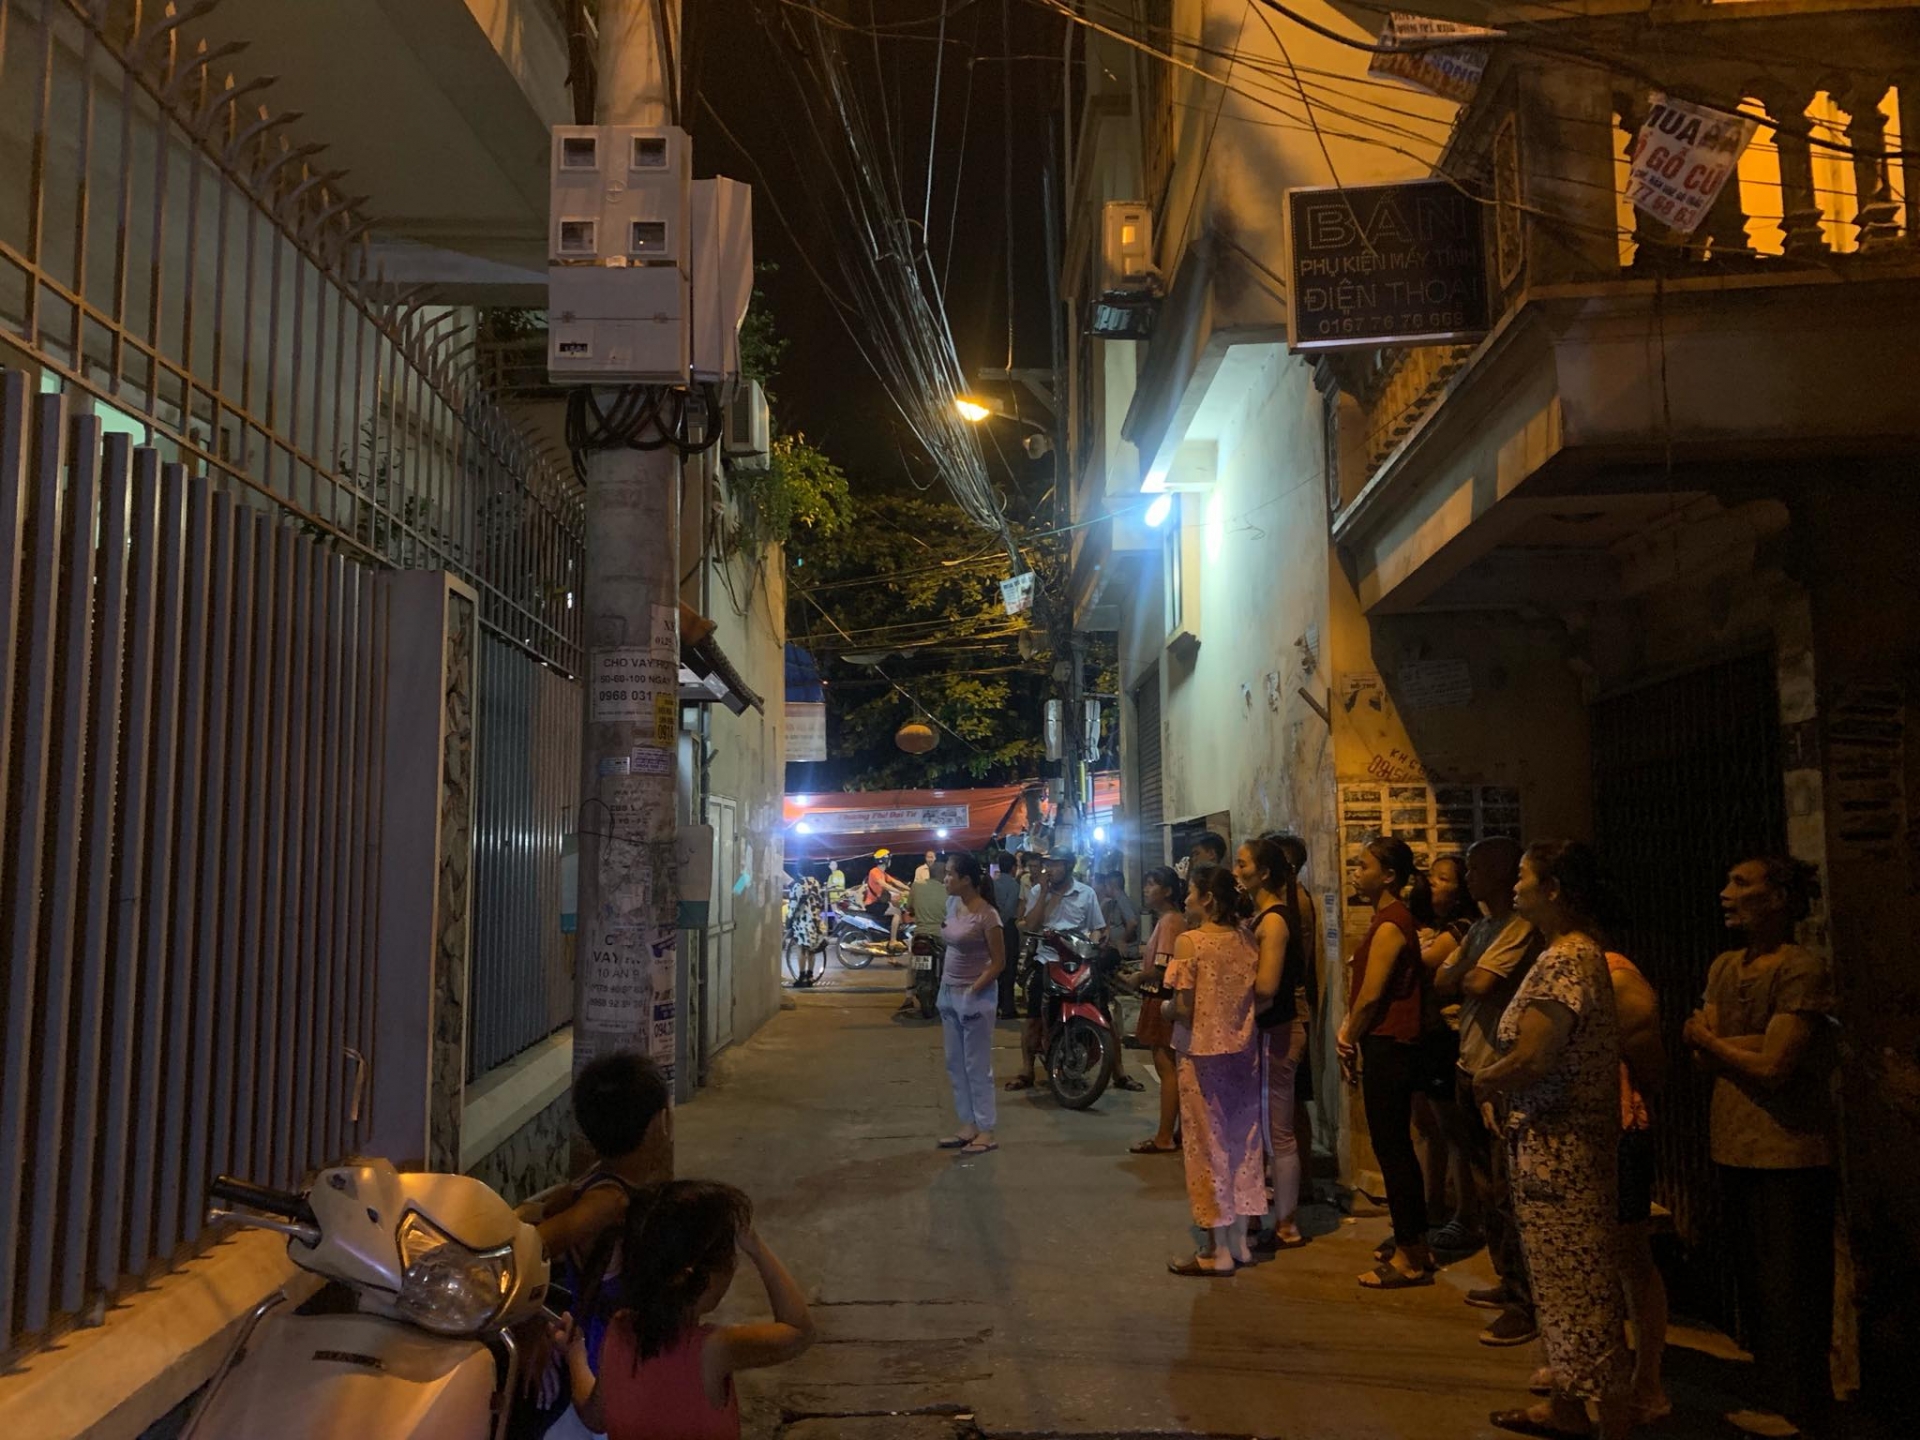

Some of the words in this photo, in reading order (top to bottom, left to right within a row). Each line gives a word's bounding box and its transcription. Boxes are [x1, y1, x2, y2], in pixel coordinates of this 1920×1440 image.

[1307, 187, 1467, 251] BÁN
[1300, 257, 1340, 277] PHỤ
[1343, 249, 1386, 275] KIỆN
[1390, 245, 1430, 270] MÁY
[1304, 278, 1376, 315] ĐIỆN
[1384, 277, 1478, 309] THOẠI
[603, 658, 628, 668] CHO
[631, 658, 653, 668] VAY
[599, 690, 627, 701] 0968
[631, 690, 652, 701] 031
